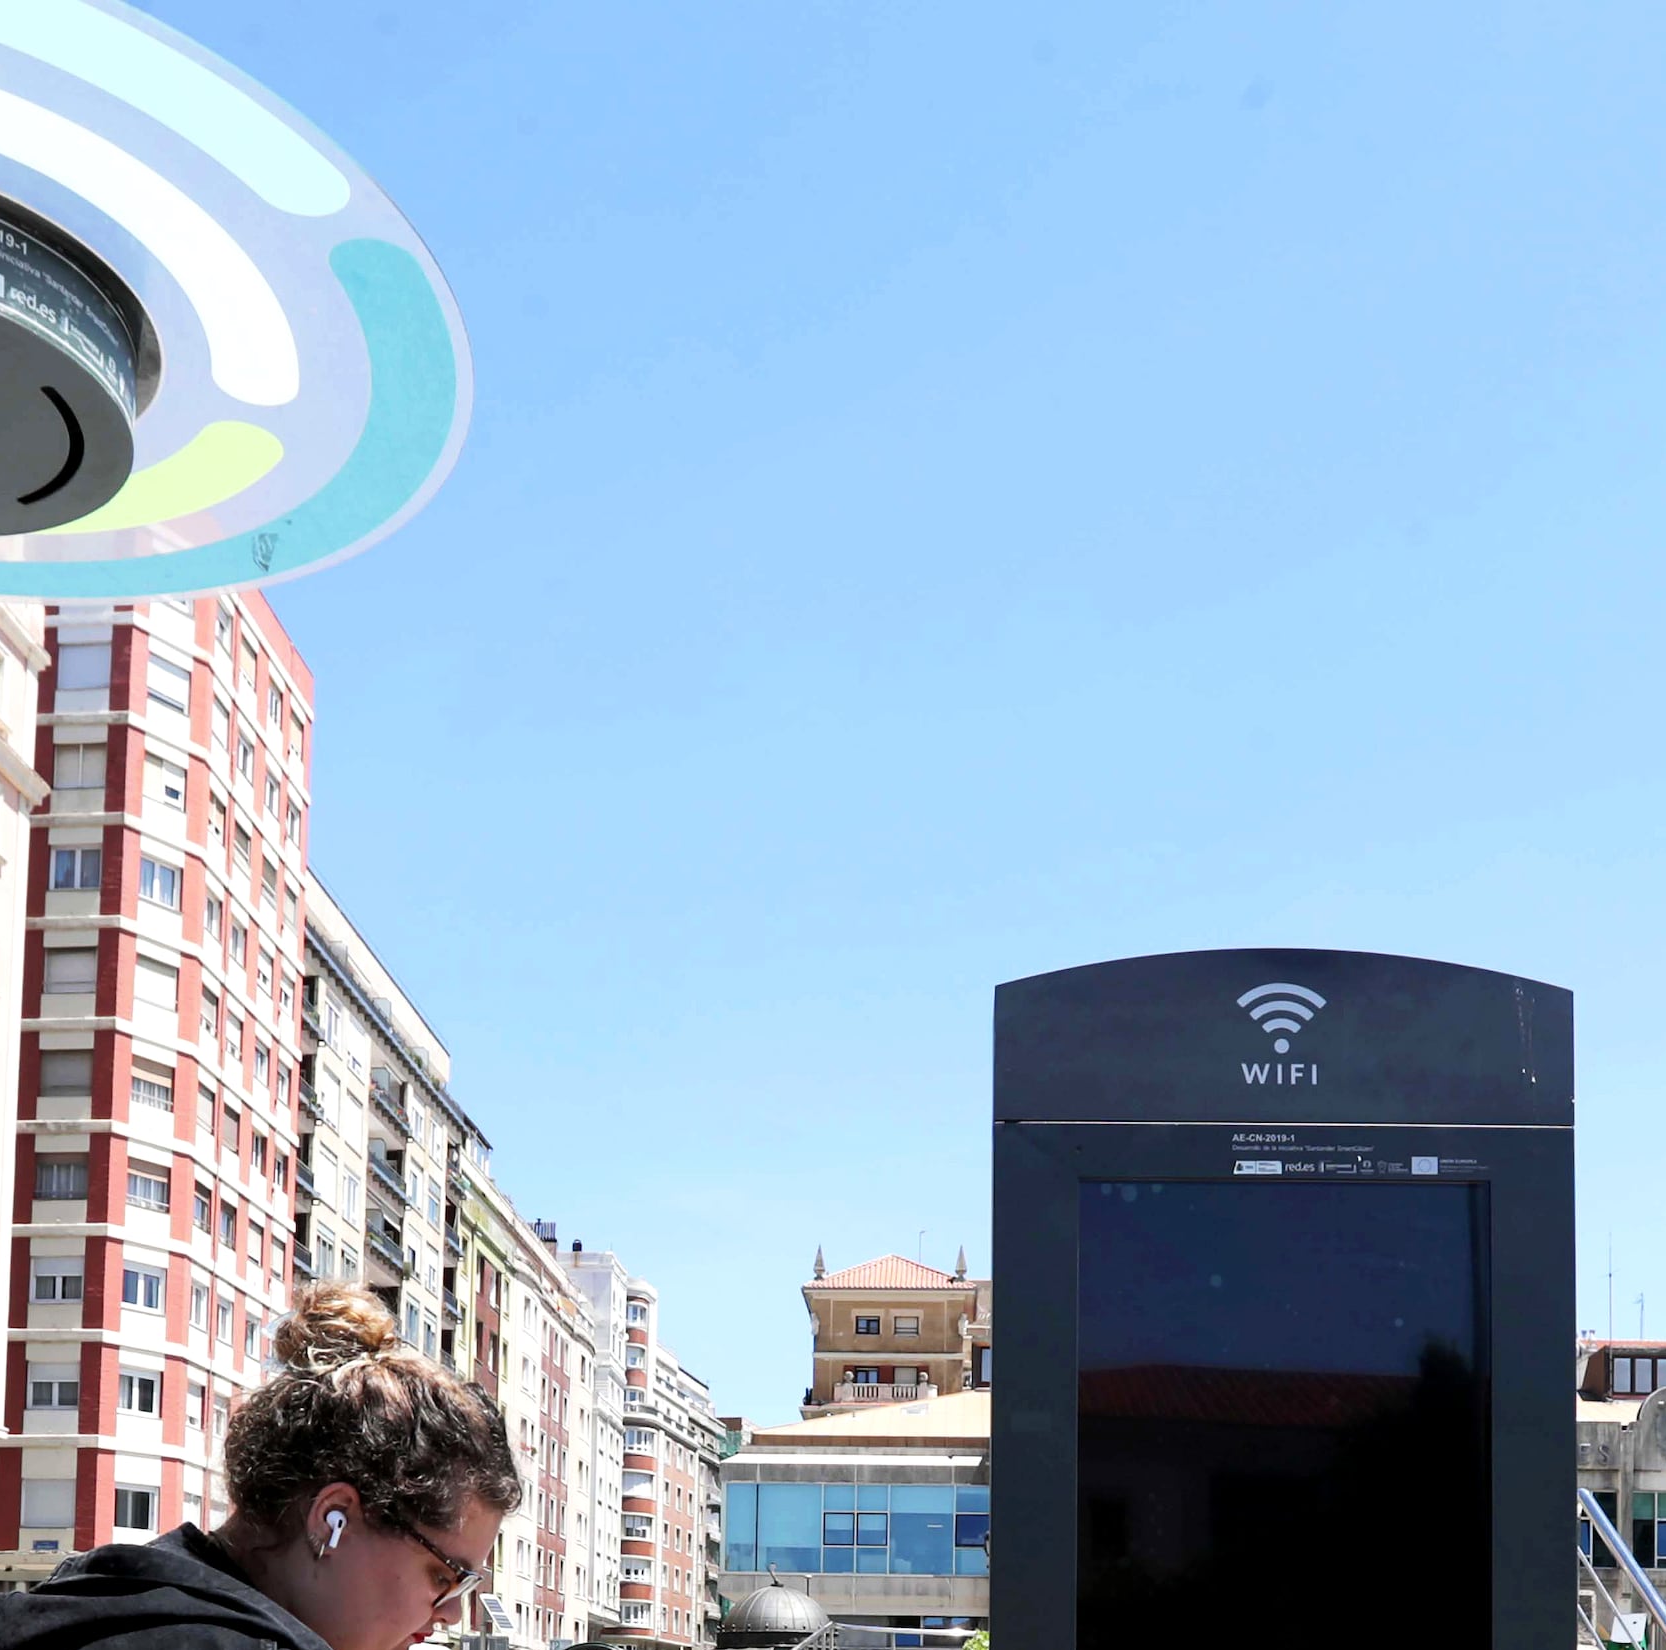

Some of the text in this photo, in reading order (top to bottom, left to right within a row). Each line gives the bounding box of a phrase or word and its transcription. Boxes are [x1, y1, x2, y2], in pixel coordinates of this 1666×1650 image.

[10, 286, 57, 324] red.es
[1241, 1063, 1318, 1086] WIFI
[1231, 1133, 1296, 1143] AE-CN-2019-1
[1284, 1161, 1316, 1173] red.es
